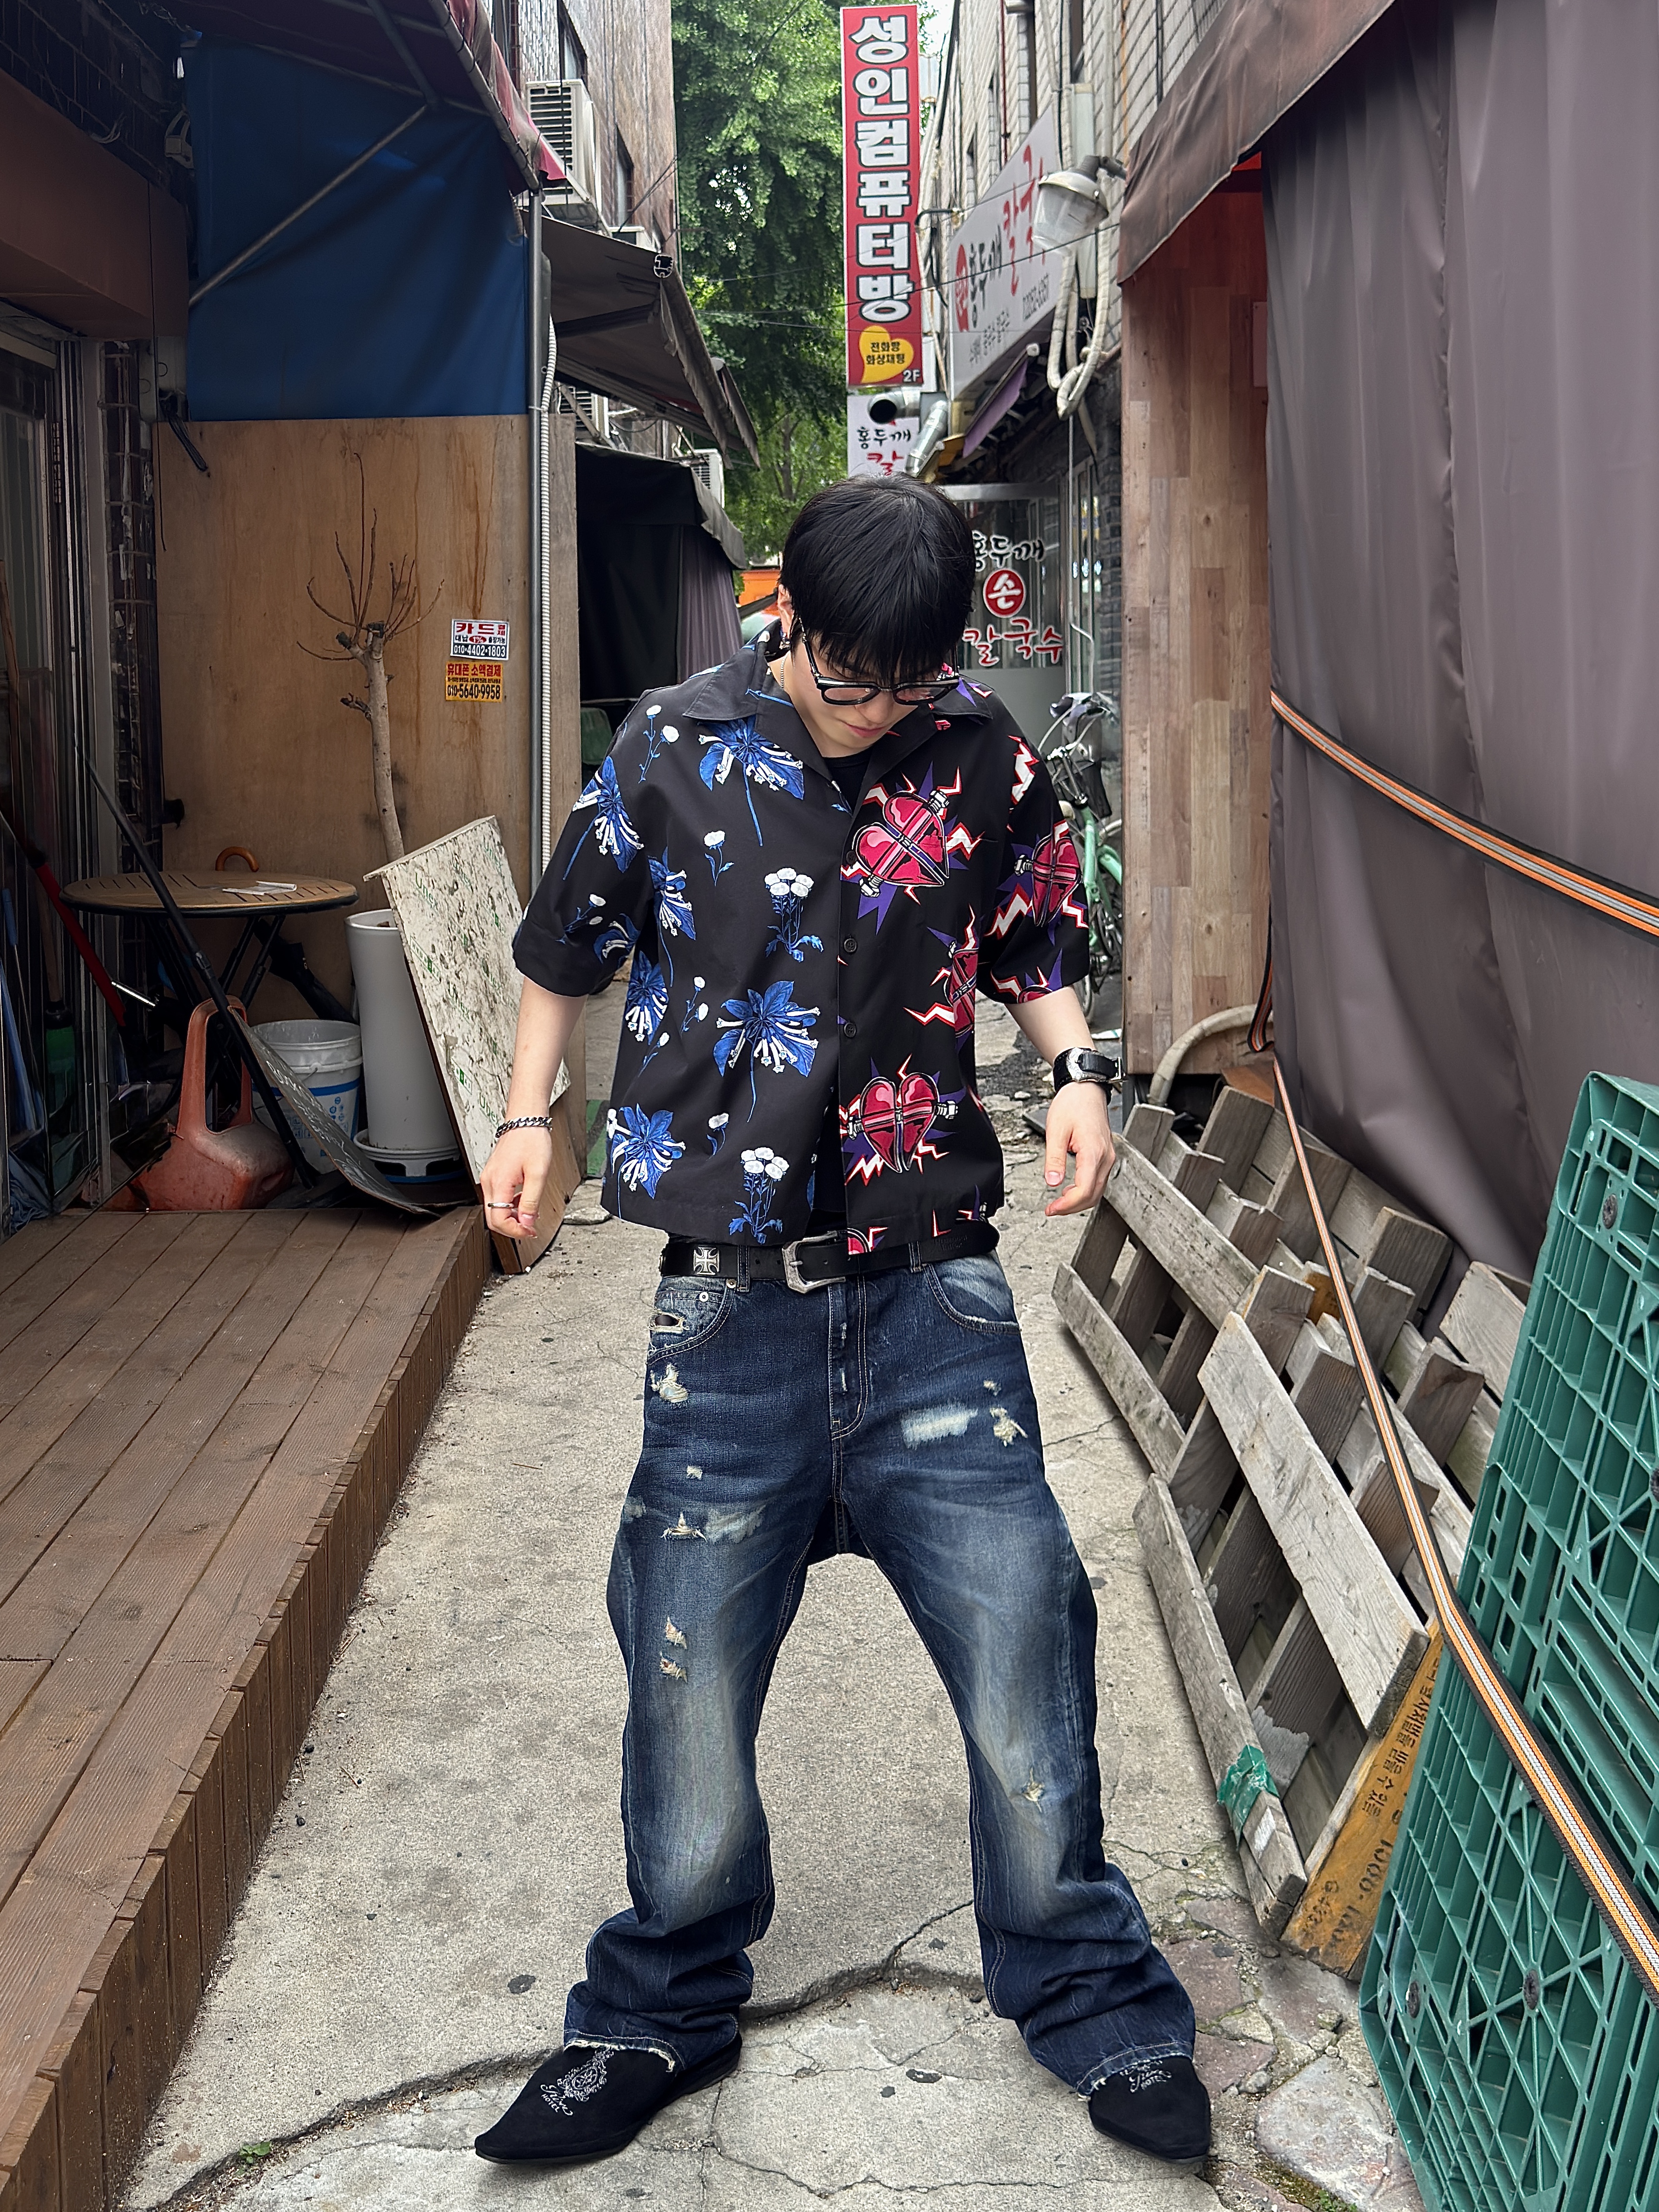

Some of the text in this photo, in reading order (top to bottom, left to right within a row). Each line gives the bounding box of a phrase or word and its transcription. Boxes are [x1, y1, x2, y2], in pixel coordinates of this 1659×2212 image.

[849, 15, 914, 323] 성인컴퓨터방
[903, 369, 920, 382] 2F
[857, 426, 911, 450] 홍두깨
[988, 573, 1022, 610] 손
[456, 623, 494, 634] 카드
[962, 618, 1062, 666] 칼국수
[447, 663, 501, 677] 휴대폰 소액결제
[1377, 1776, 1394, 1790] 수
[541, 2093, 560, 2113] HOTEL
